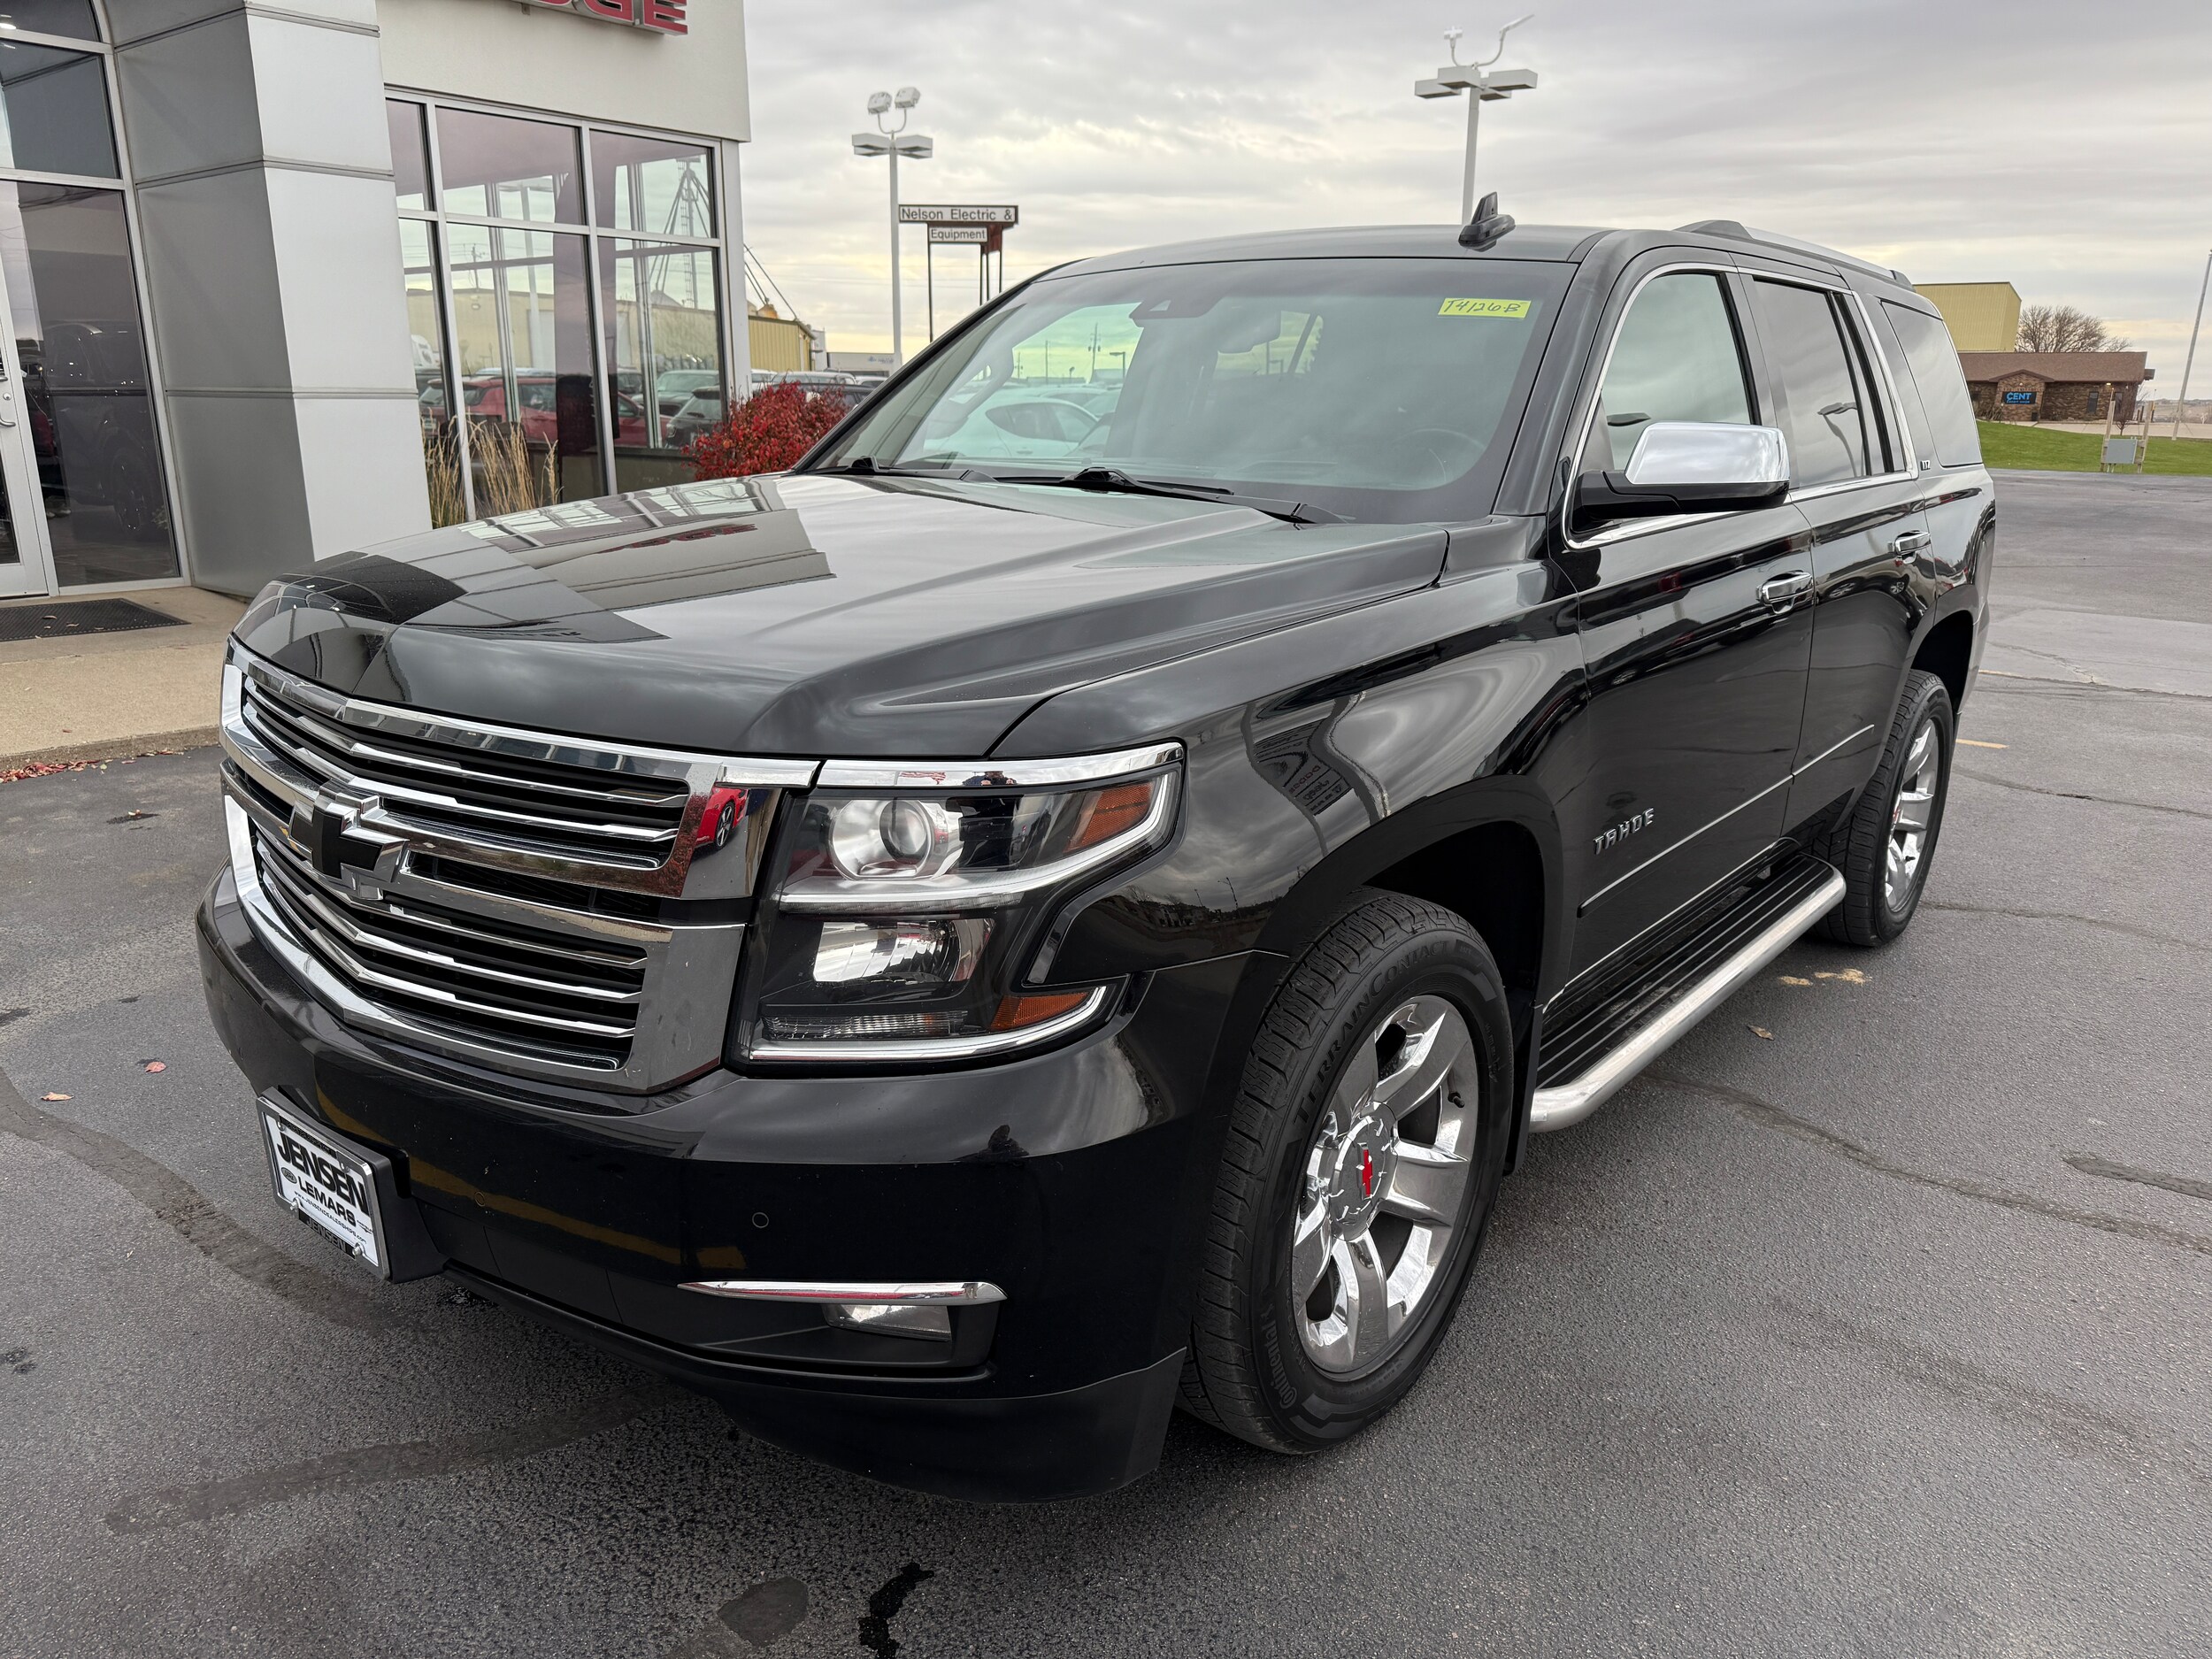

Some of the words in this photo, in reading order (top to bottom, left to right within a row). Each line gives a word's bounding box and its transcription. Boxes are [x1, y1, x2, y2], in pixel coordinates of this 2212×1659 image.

[902, 208, 943, 220] Nelson
[950, 208, 996, 220] Electric
[1003, 209, 1013, 220] &
[931, 228, 986, 241] Equipment
[1593, 808, 1654, 855] TAHOE
[277, 1132, 369, 1215] JENSEN
[297, 1176, 357, 1227] LEMARS
[306, 1217, 346, 1252] JENSEN
[1260, 1318, 1299, 1409] Continental
